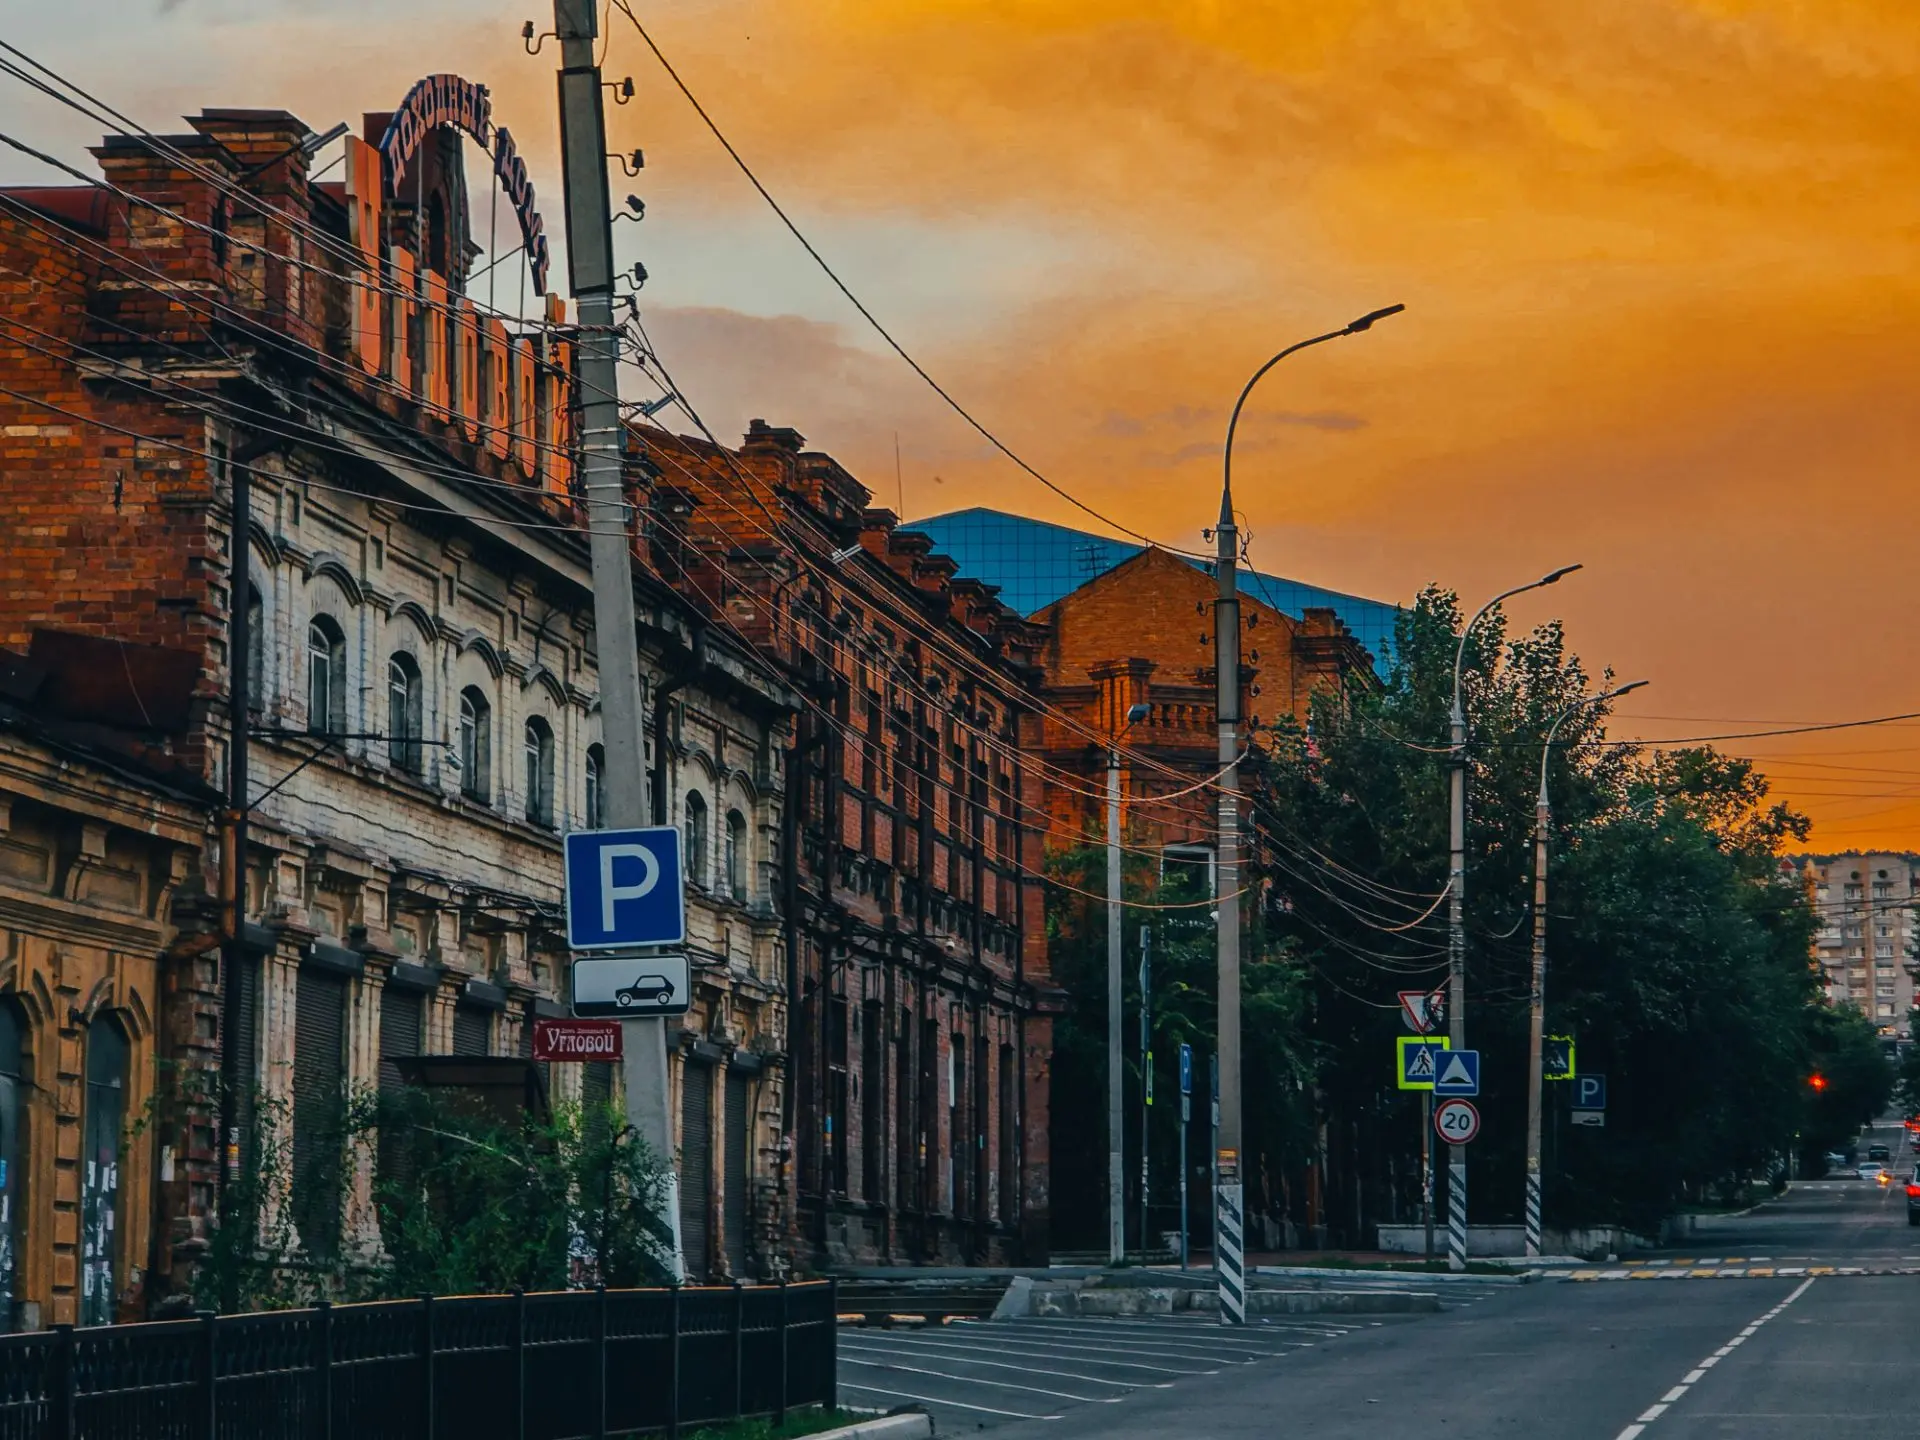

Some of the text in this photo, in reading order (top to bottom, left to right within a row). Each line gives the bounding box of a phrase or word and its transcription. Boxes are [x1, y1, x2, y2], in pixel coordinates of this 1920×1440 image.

[600, 844, 660, 932] P
[1581, 1078, 1599, 1104] P
[1444, 1112, 1470, 1131] 20
